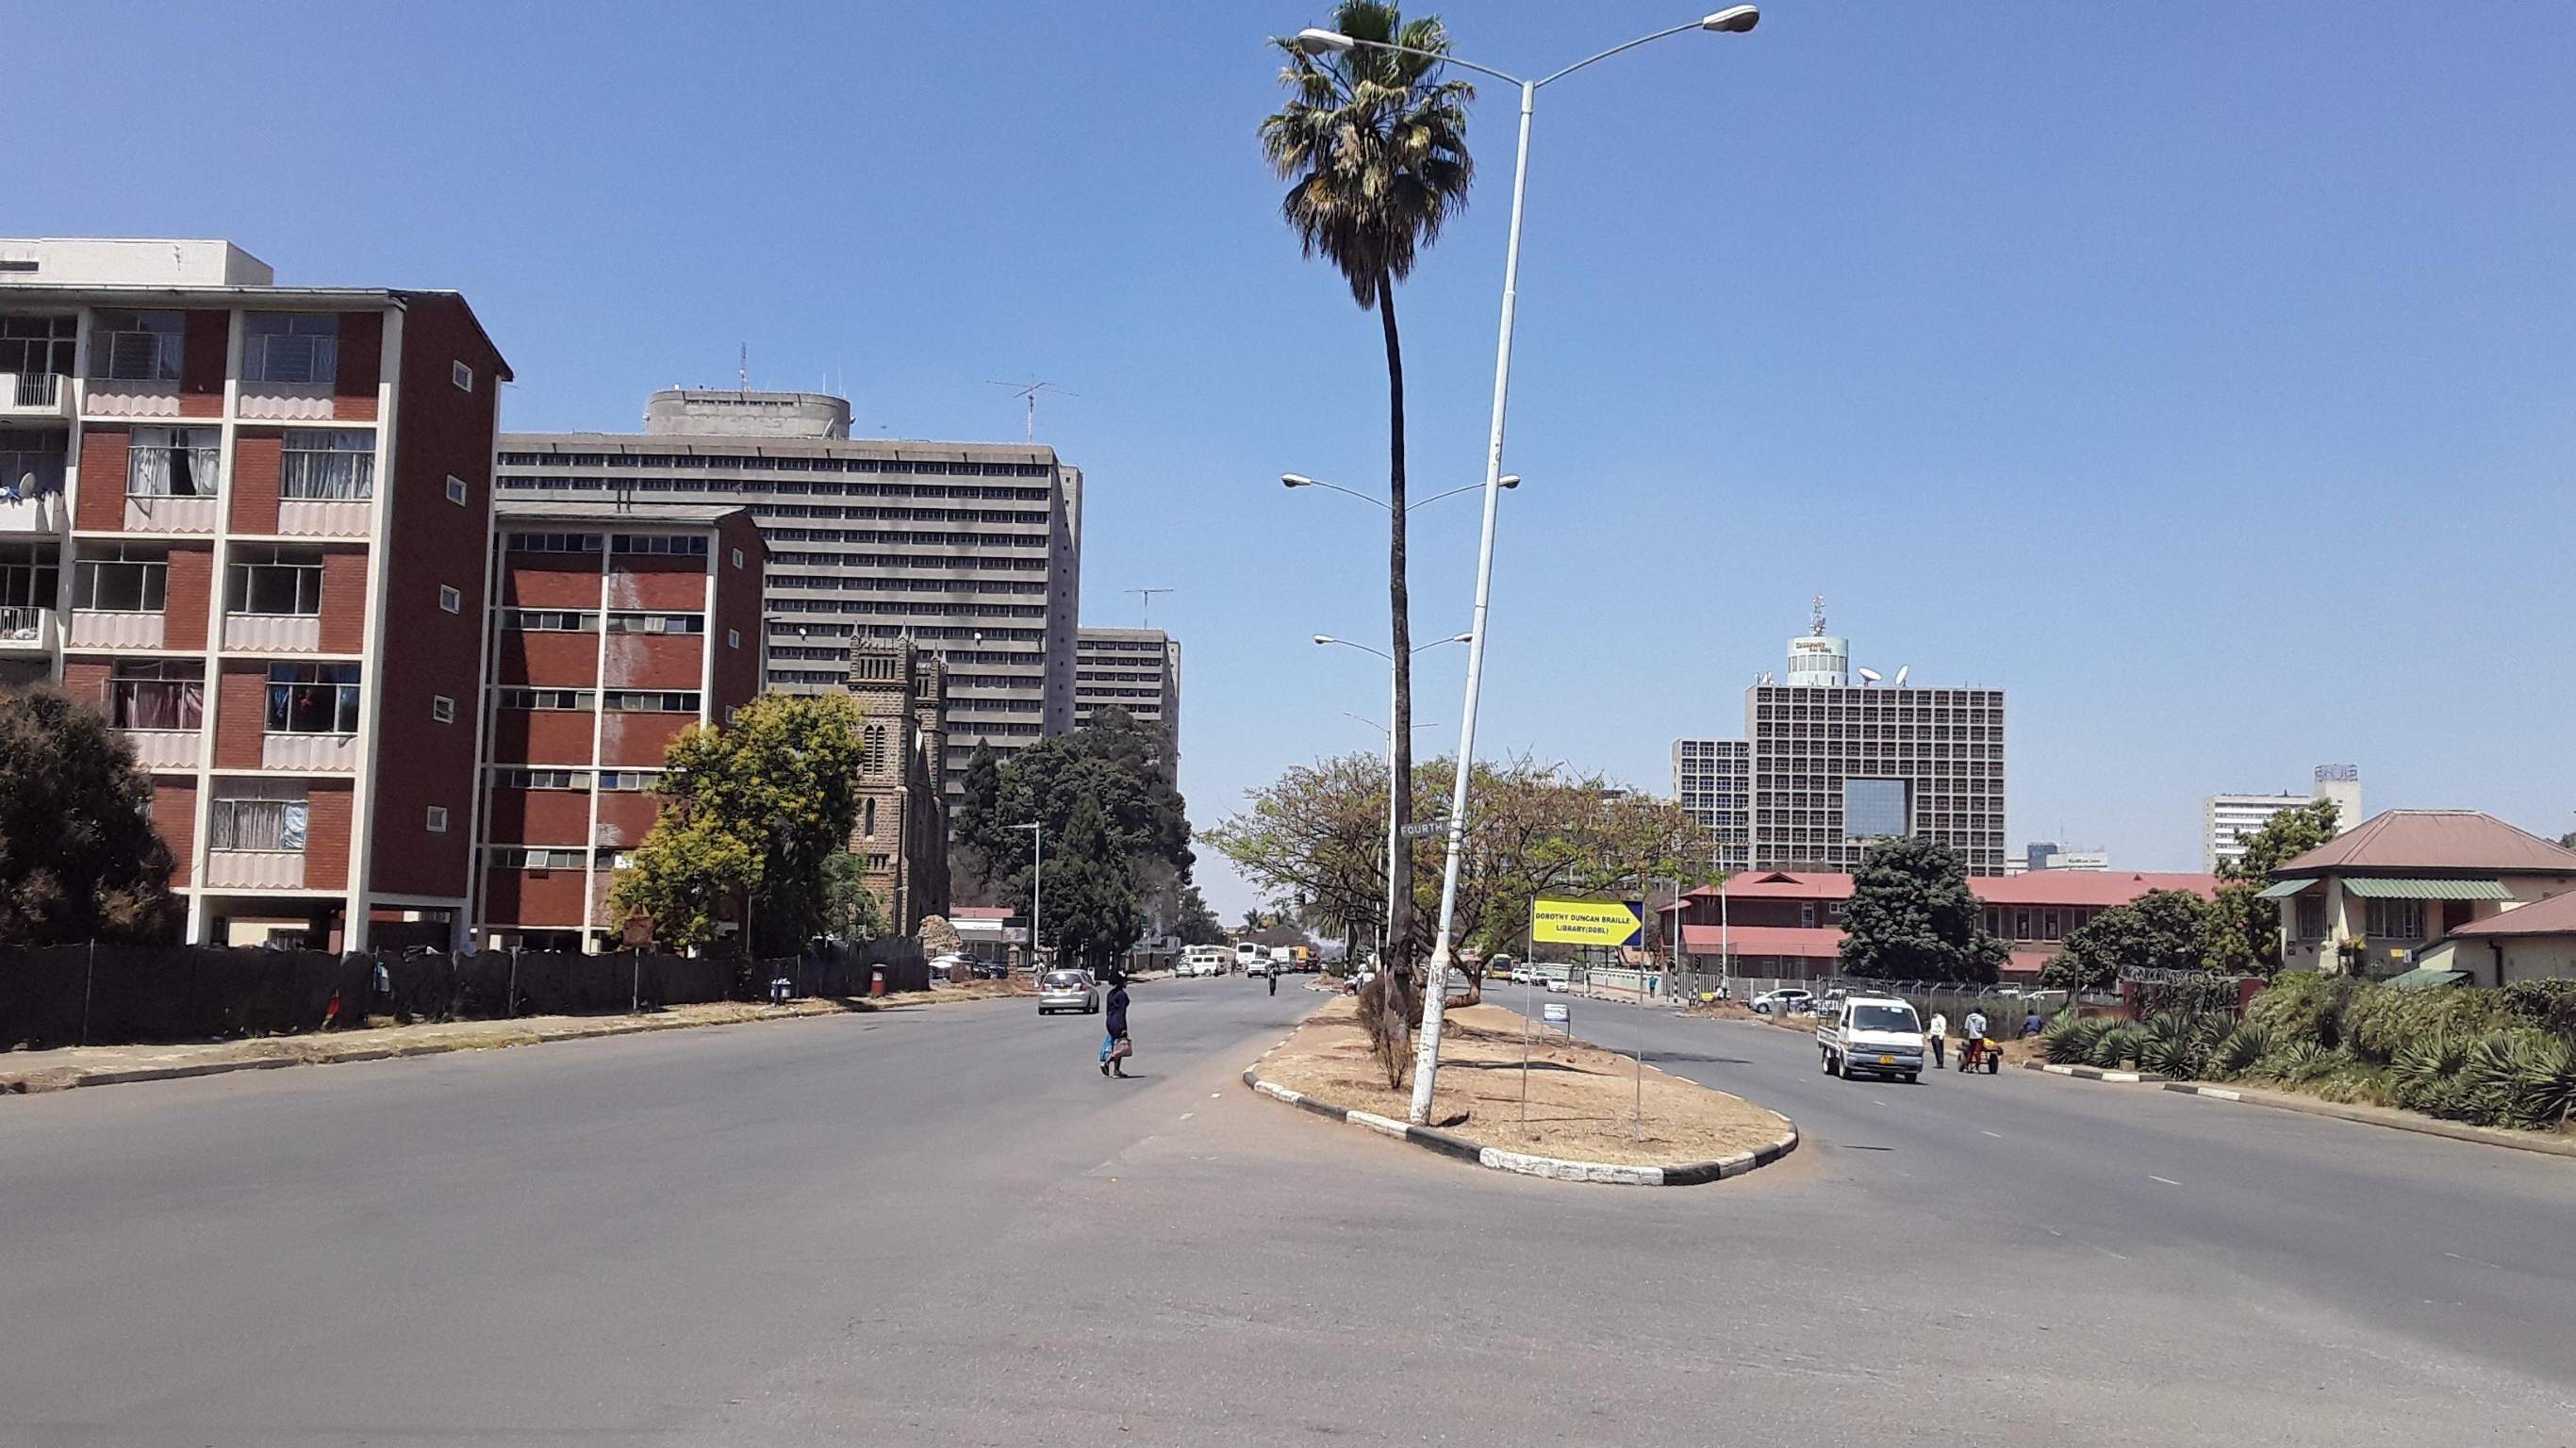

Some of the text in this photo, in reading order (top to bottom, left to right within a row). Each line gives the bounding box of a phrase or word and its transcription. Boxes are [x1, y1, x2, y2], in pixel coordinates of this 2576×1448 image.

[1400, 822, 1443, 836] FOURTH
[1570, 913, 1600, 922] DUNCAN
[1601, 915, 1630, 924] BRAILLE
